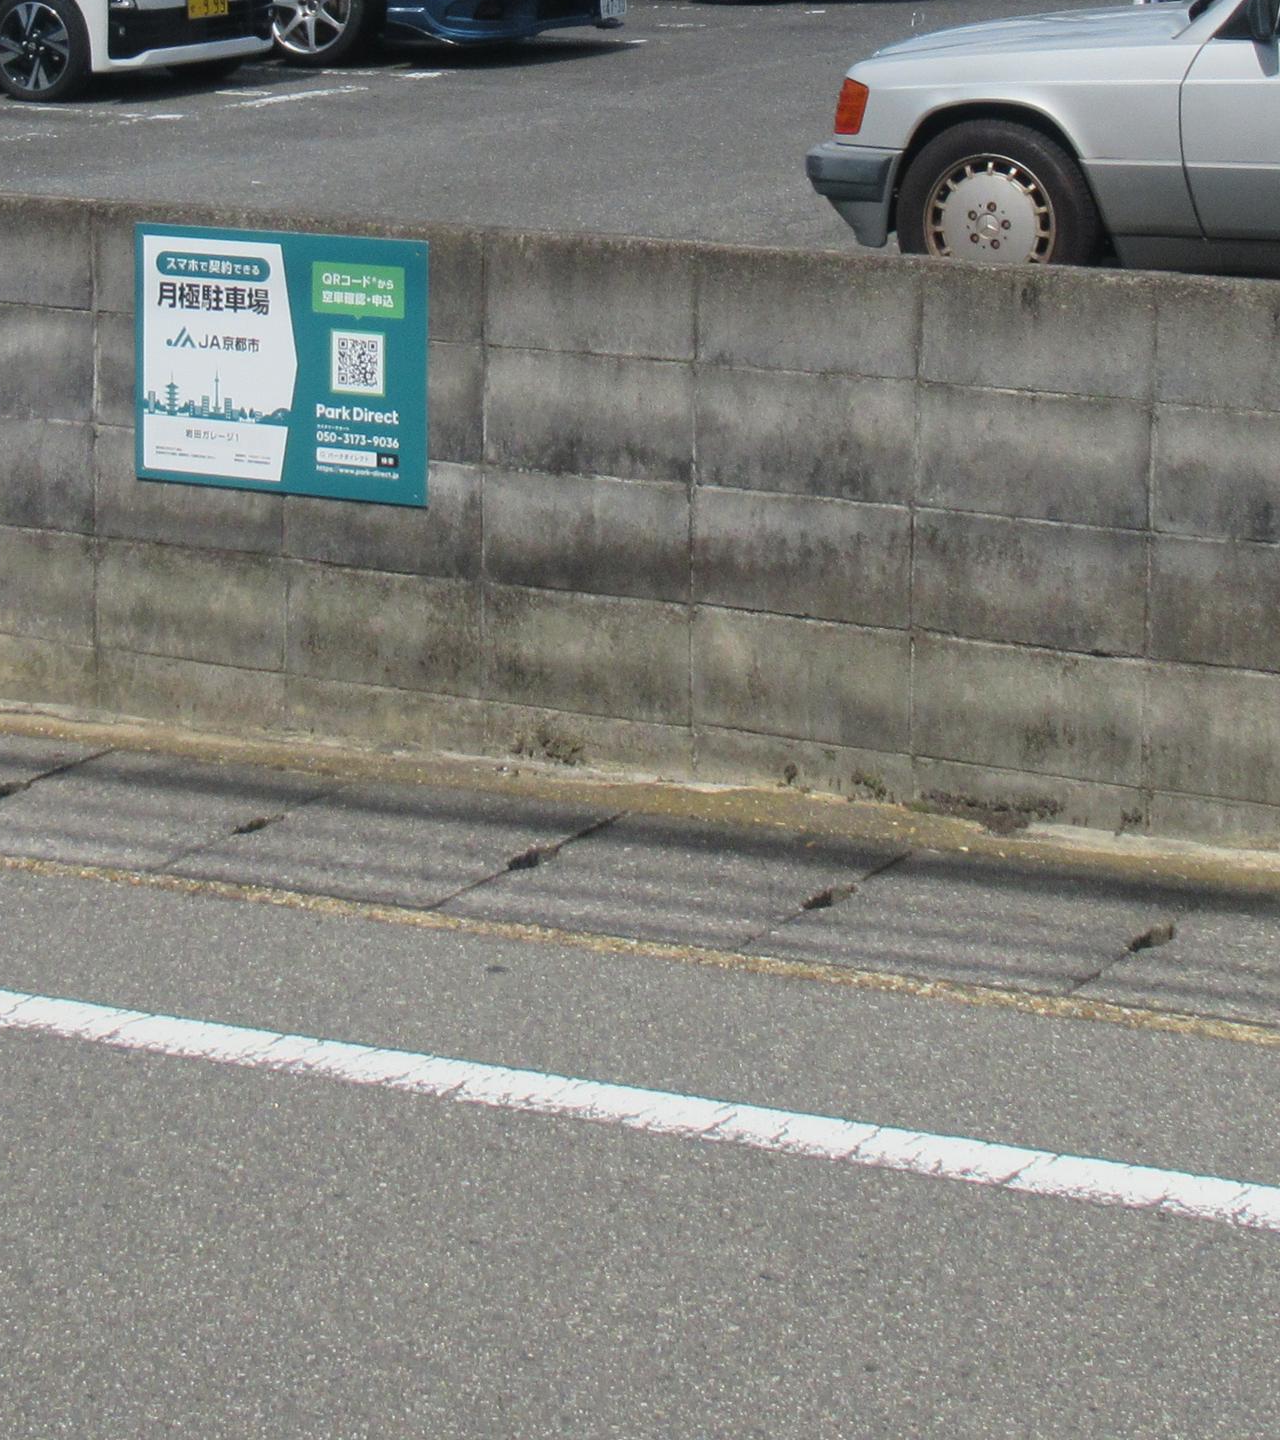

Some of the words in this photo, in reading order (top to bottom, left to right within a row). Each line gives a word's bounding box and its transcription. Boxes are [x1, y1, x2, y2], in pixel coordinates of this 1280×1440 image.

[166, 257, 261, 276] スマホで契約できる
[157, 282, 270, 316] 月極駐車場
[198, 334, 260, 353] JA京都市
[316, 403, 351, 421] Park
[353, 407, 400, 425] Direct
[316, 431, 400, 449] 050-3173-9036
